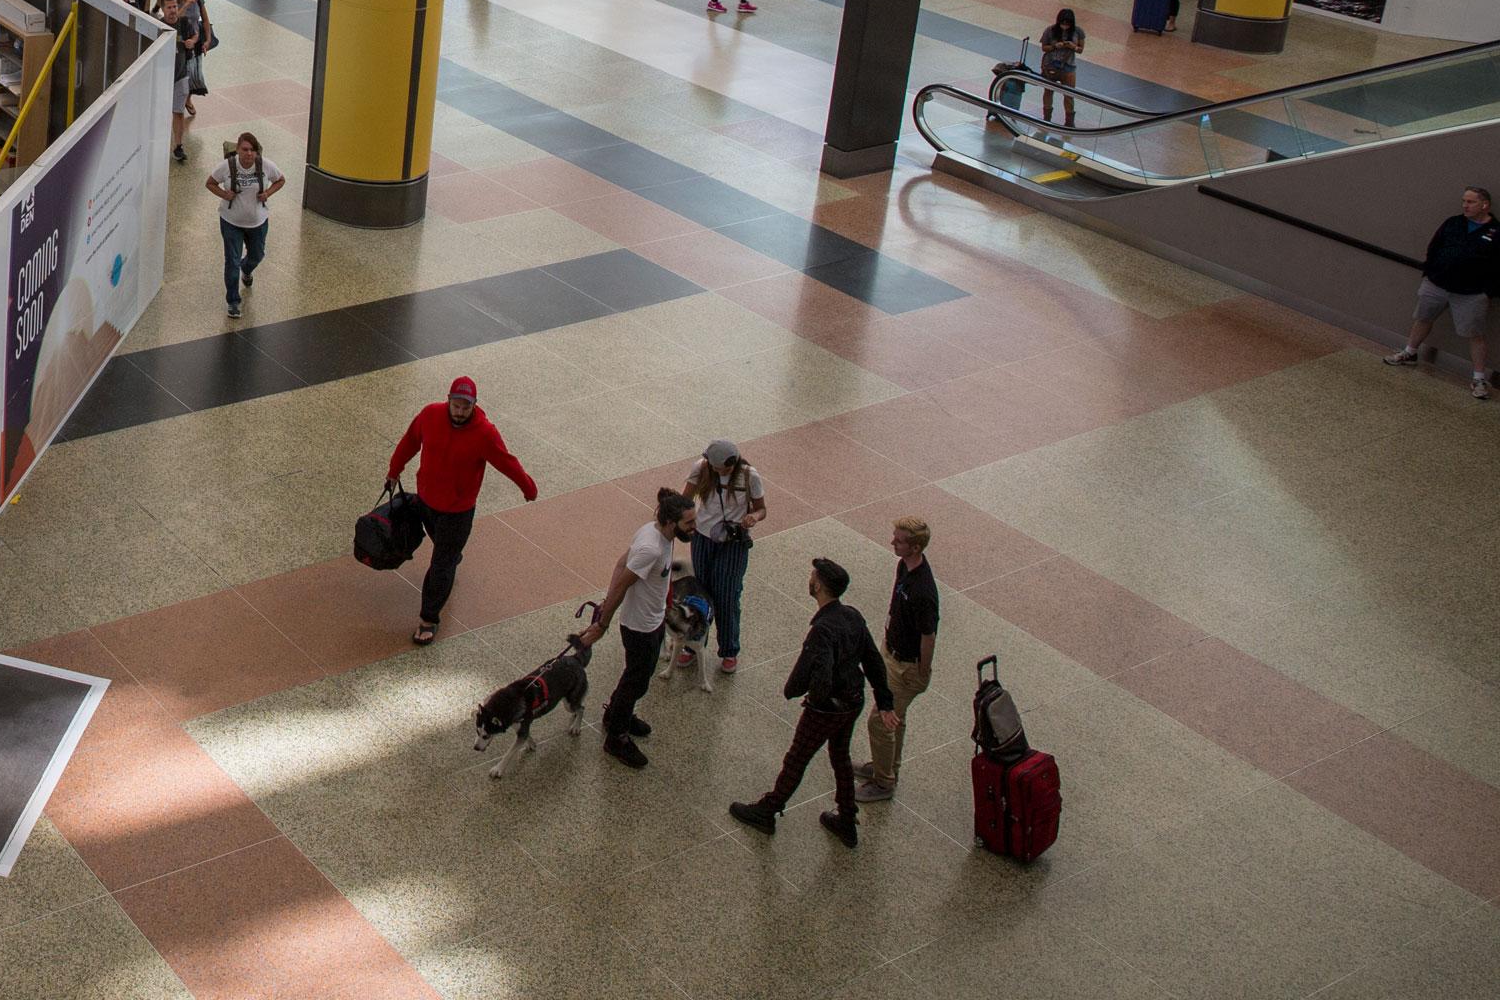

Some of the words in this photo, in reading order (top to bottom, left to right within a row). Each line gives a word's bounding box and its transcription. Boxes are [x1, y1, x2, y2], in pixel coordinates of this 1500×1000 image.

[20, 207, 35, 233] DEN
[17, 228, 59, 313] COMING
[15, 291, 44, 360] SOON
